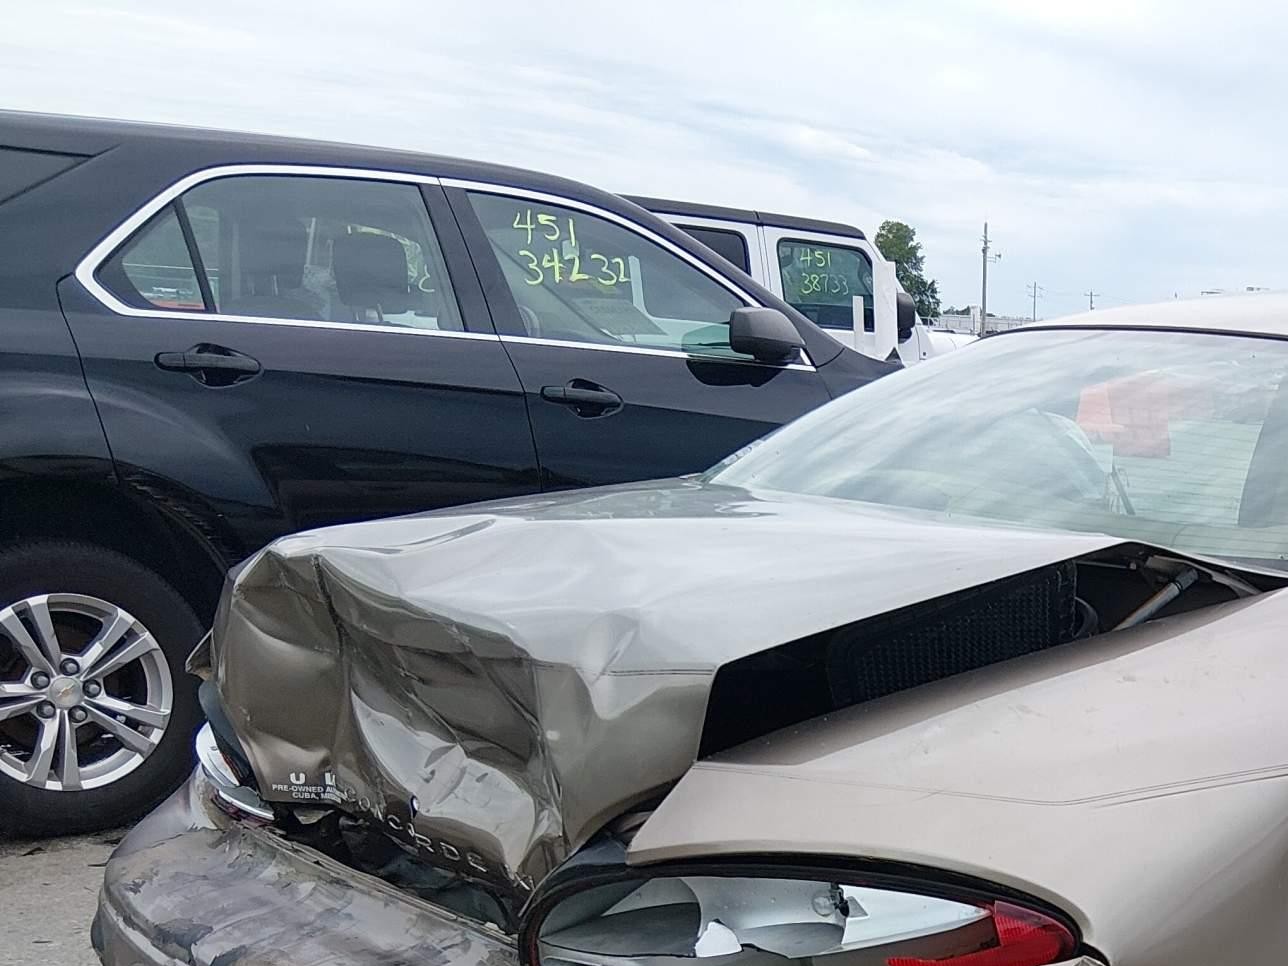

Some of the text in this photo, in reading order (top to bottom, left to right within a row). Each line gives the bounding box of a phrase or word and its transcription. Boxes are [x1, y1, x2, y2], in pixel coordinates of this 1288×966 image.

[513, 209, 576, 247] 451
[518, 247, 632, 285] 34232
[799, 248, 831, 268] 451
[801, 272, 849, 295] 38733
[271, 783, 324, 793] PRE-OWNED
[292, 792, 319, 800] CUBA,
